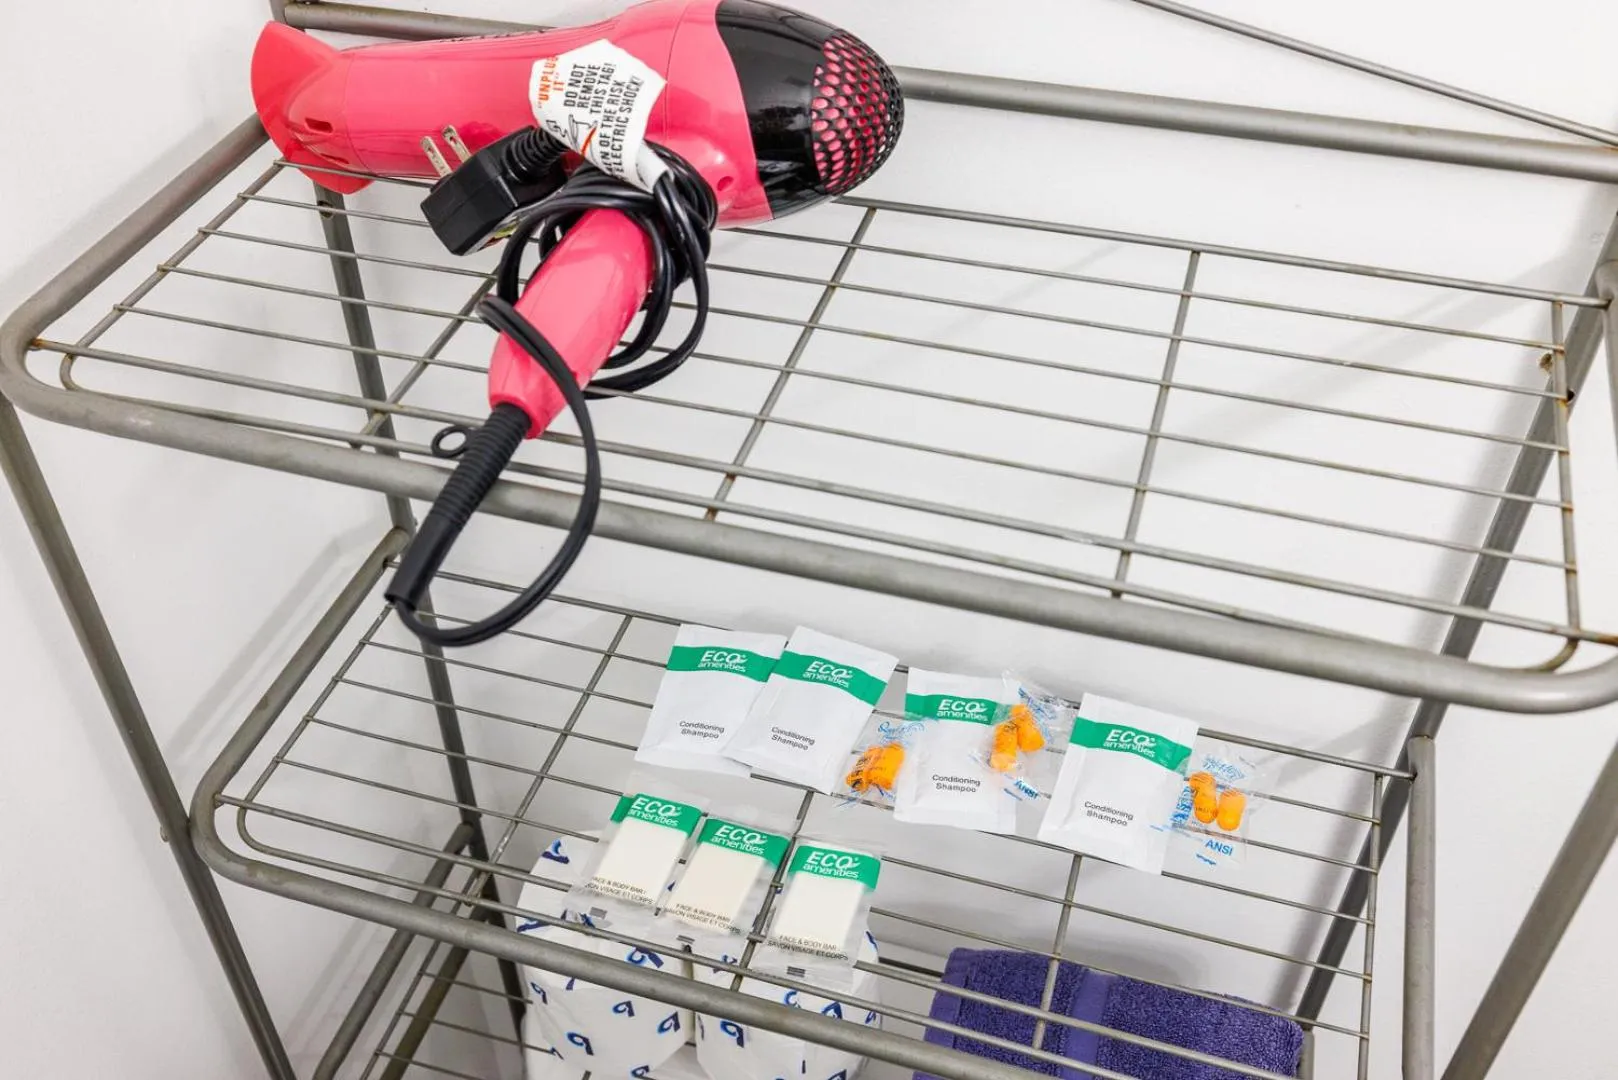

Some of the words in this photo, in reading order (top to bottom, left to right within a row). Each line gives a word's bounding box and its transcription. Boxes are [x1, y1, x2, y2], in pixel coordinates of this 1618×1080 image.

[567, 64, 586, 87] NOT
[598, 62, 617, 85] TAG!
[577, 65, 601, 108] REMOVE
[607, 79, 626, 105] RISK
[624, 75, 644, 114] SHOCK!
[564, 91, 577, 107] DO
[590, 89, 607, 115] THIS
[601, 105, 617, 128] THE
[600, 130, 612, 147] OF
[701, 650, 741, 663] ECO
[697, 660, 746, 672] amenities
[807, 661, 847, 678] ECO
[803, 671, 849, 688] amenities
[938, 699, 980, 712] ECO
[936, 710, 987, 721] amenities
[679, 721, 725, 733] Conditioning
[681, 729, 719, 739] Shampoo
[772, 726, 815, 745] Conditioning
[772, 734, 808, 750] Shampoo
[1107, 729, 1149, 746] ECO
[1103, 741, 1155, 758] amenities
[933, 774, 980, 786] Conditioning
[936, 783, 976, 793] Shampoo
[632, 797, 676, 816] ECO
[1084, 801, 1134, 821] Conditioning
[628, 809, 678, 826] amenities
[1086, 811, 1128, 826] Shampoo
[715, 825, 762, 845] ECO
[711, 836, 764, 855] amenities
[1205, 839, 1233, 856] ANSI
[807, 852, 854, 869] ECO
[803, 863, 858, 878] amenities
[612, 881, 629, 891] BODY
[767, 940, 791, 952] SAVON
[791, 945, 815, 955] VISAGE
[825, 952, 848, 961] CORPS
[779, 935, 797, 945] FACE
[804, 940, 822, 948] BODY
[823, 943, 837, 951] BAR
